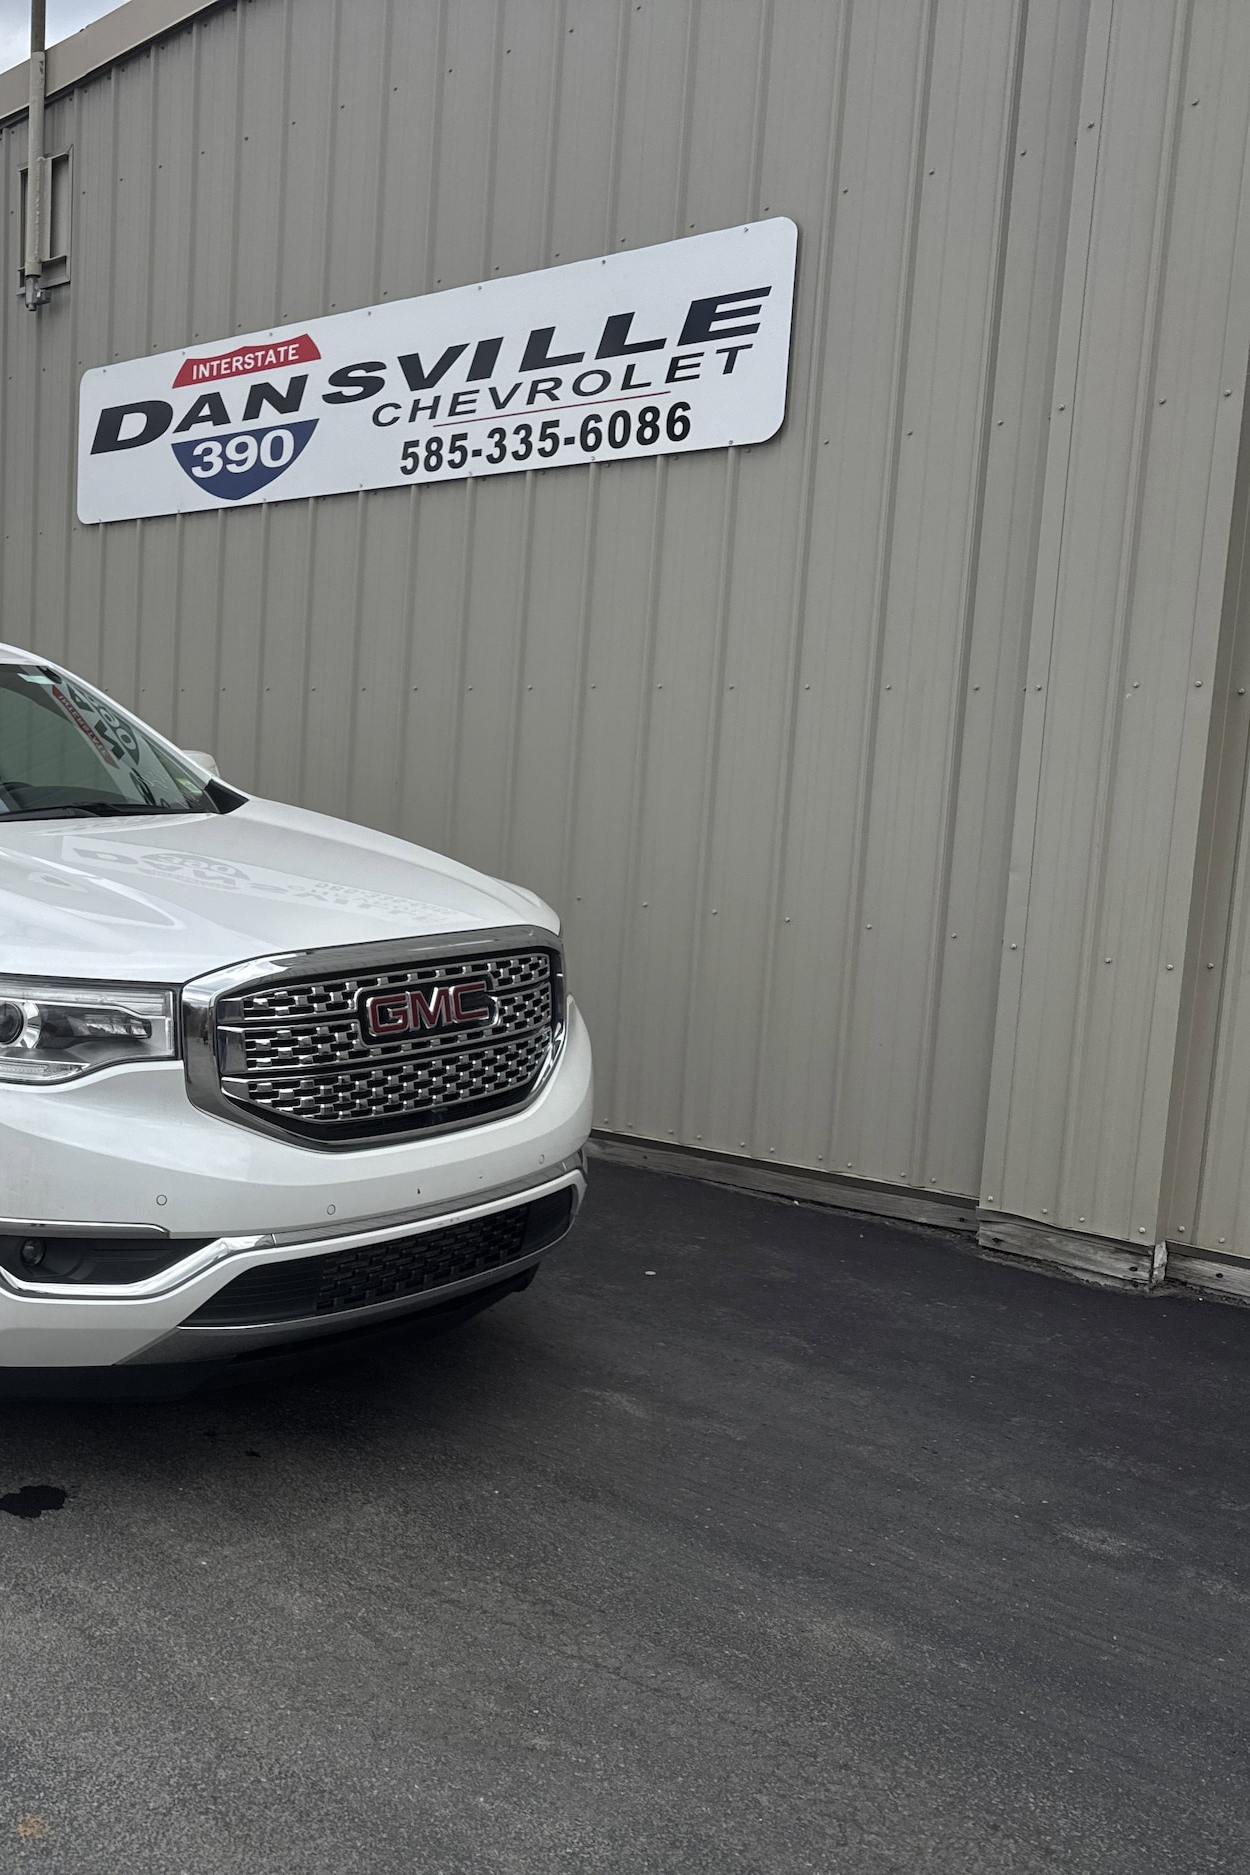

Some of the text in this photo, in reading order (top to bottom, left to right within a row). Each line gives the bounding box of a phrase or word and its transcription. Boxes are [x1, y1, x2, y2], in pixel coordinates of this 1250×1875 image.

[192, 343, 299, 381] INTERSTATE
[372, 343, 753, 427] CHEVROLET
[191, 428, 295, 478] 390
[400, 401, 692, 476] 585-335-6086
[366, 980, 489, 1037] GMC
